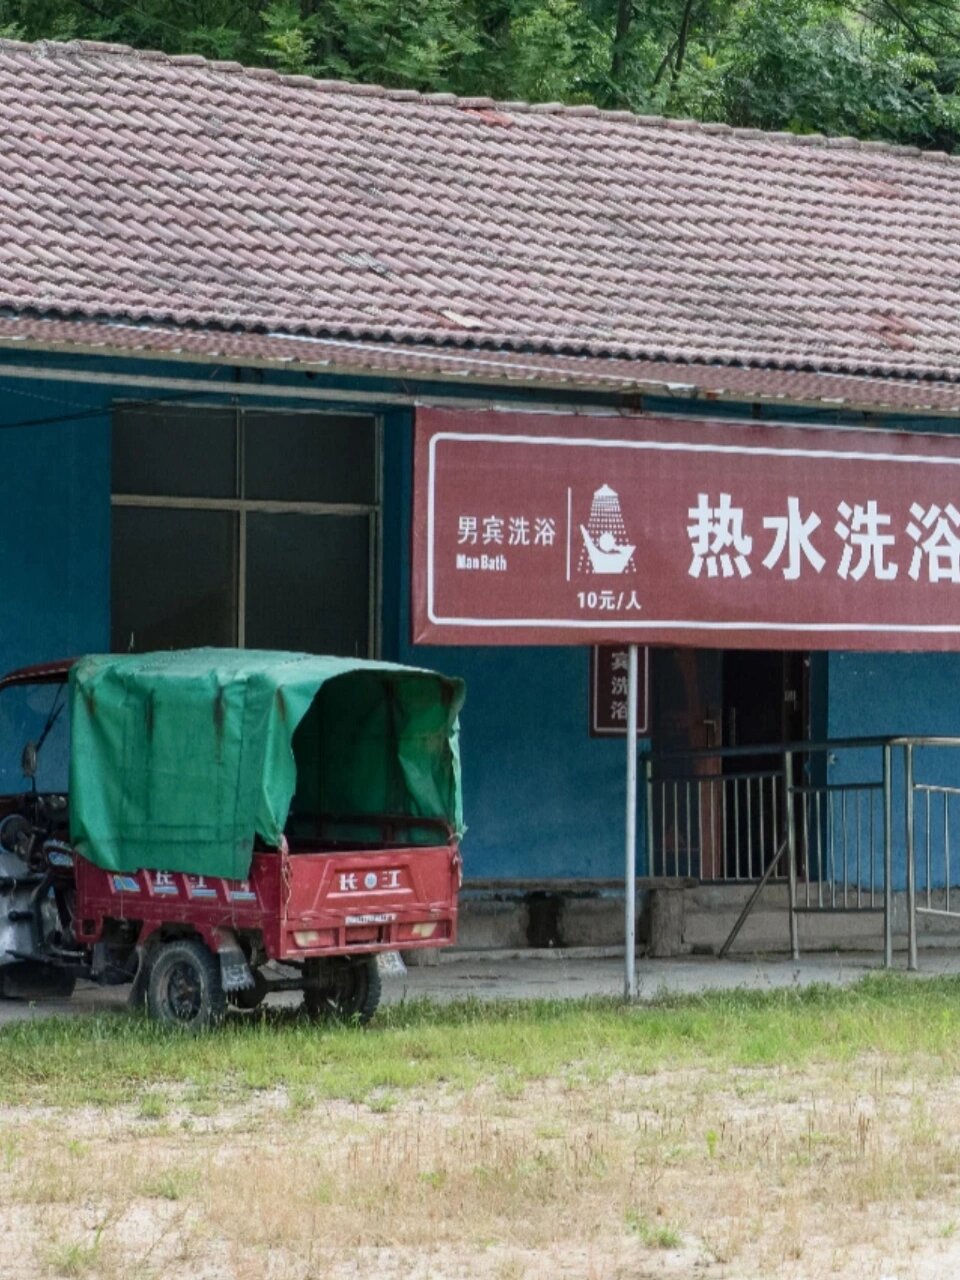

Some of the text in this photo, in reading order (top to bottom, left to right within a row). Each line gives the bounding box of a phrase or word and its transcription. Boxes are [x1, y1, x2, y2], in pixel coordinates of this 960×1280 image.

[457, 515, 556, 546] 男宾洗浴
[456, 554, 507, 571] Man Bath
[577, 590, 642, 610] 10元/人
